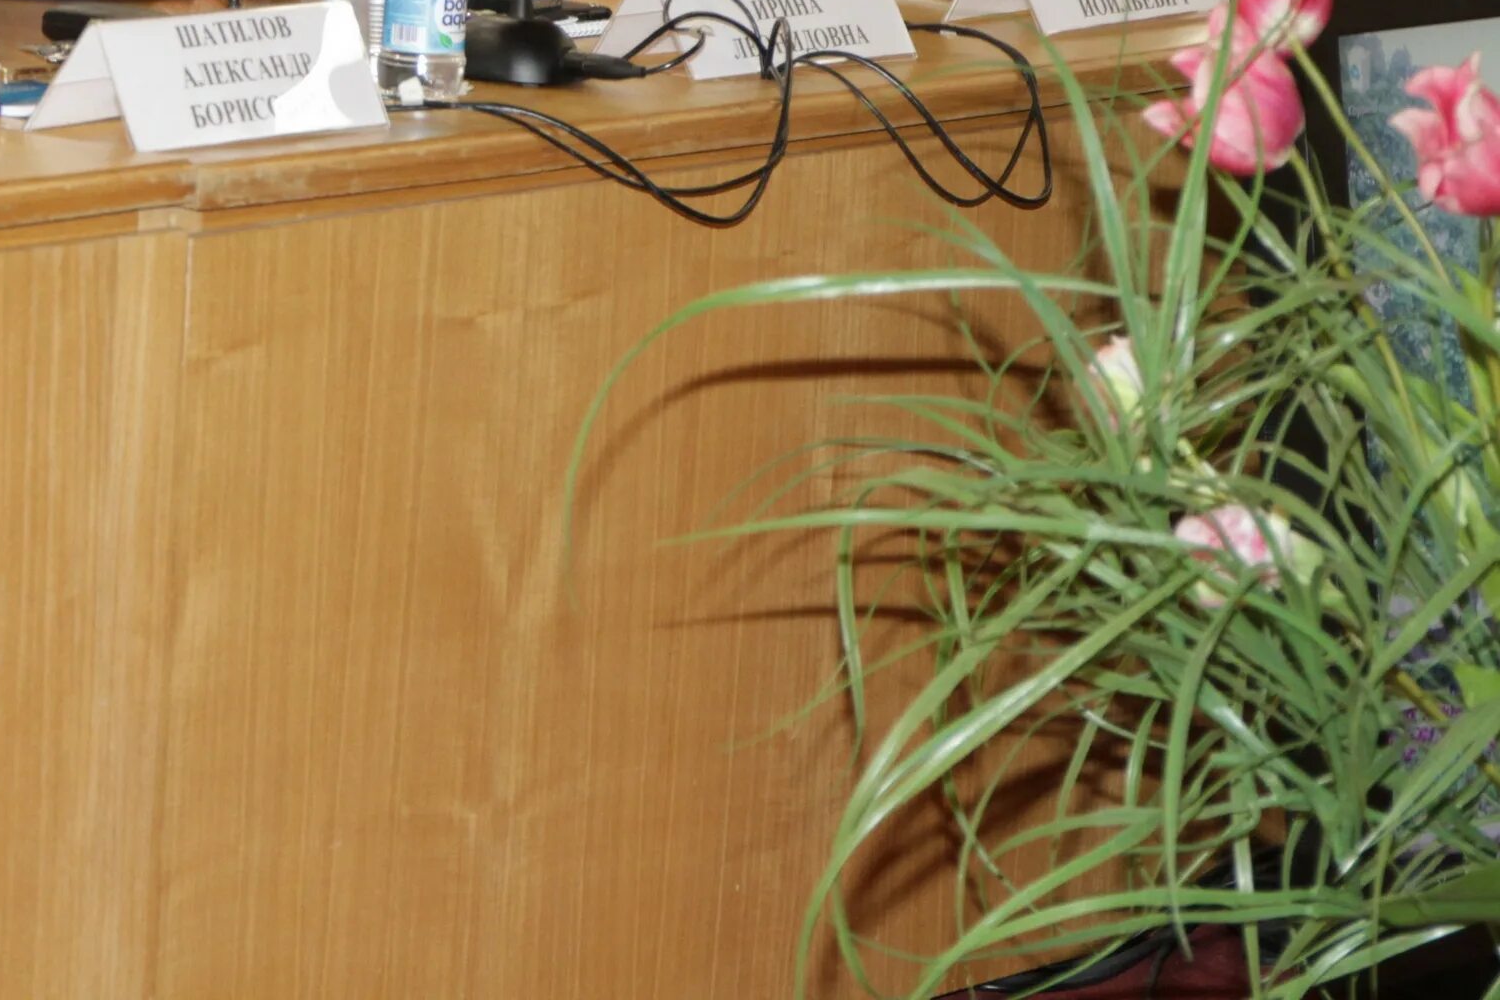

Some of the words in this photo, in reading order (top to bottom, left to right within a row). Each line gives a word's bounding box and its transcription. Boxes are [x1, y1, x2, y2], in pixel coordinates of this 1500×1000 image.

[175, 15, 292, 49] ШАТИЛОВ
[732, 23, 870, 61] ЛЕНИДОВНА
[183, 52, 312, 89] АЛЕКСАНДР
